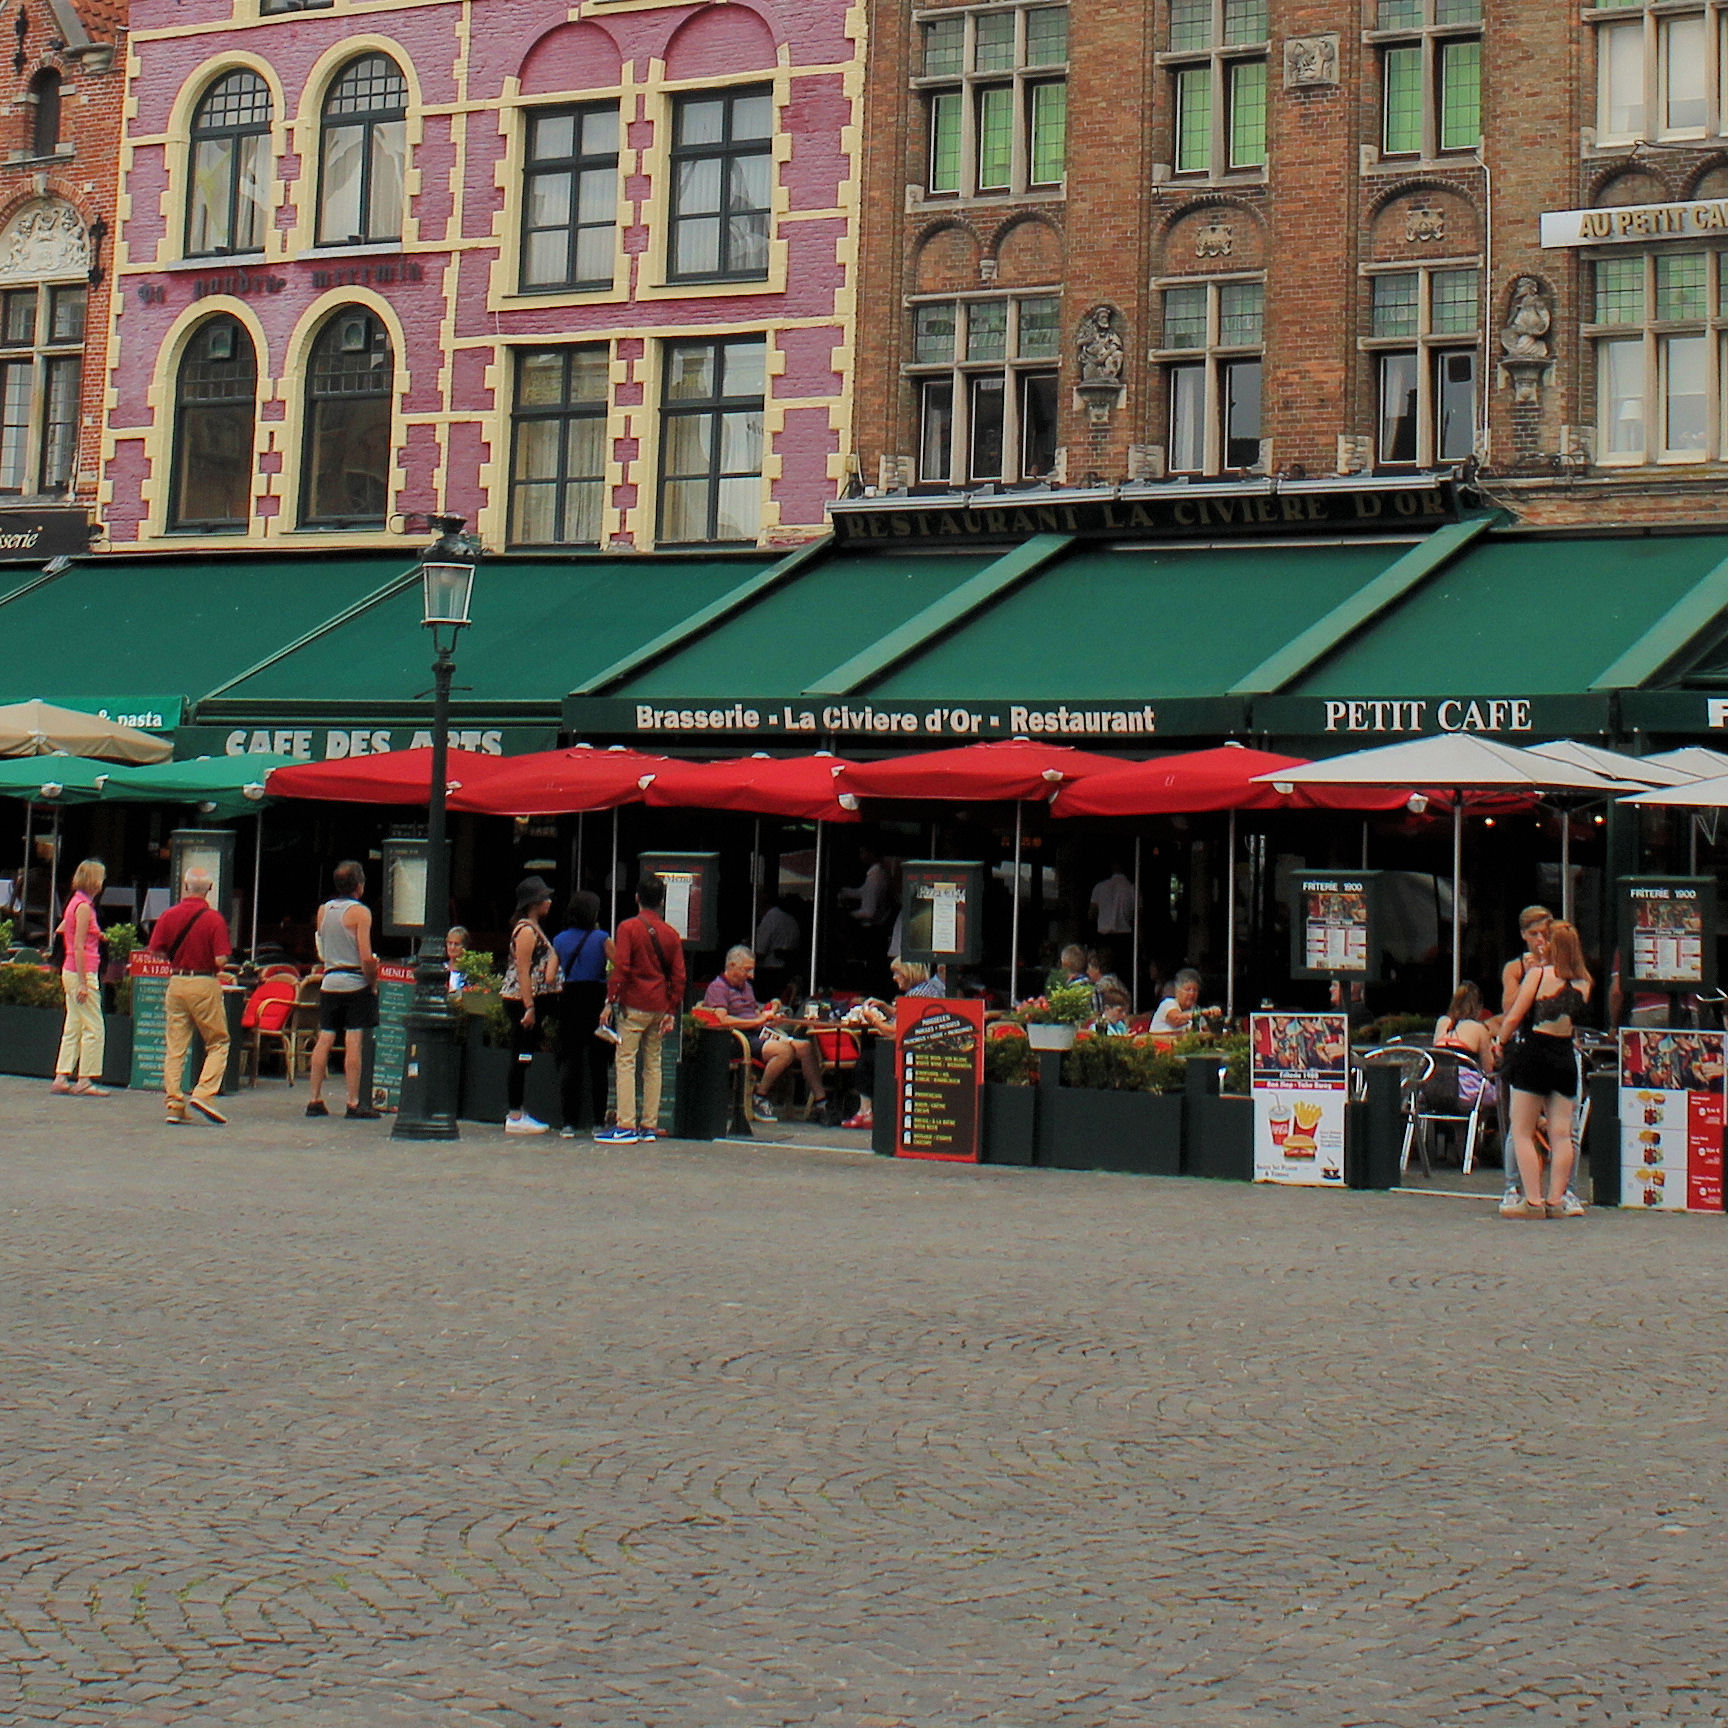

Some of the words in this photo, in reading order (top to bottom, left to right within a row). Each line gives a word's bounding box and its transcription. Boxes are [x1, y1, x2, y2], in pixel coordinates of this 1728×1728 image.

[1579, 213, 1611, 238] AU
[1616, 207, 1686, 236] PETIT
[848, 505, 1078, 538] RESTAURANT
[1103, 503, 1154, 528] LA
[636, 704, 760, 730] Brasserie
[784, 706, 816, 730] La
[824, 705, 918, 732] Civiere
[925, 706, 983, 733] d'Or
[1010, 704, 1156, 735] Restaurant
[1324, 700, 1427, 732] PETIT
[1437, 699, 1533, 732] CAFE
[225, 730, 313, 760] CAFE
[325, 730, 392, 760] DES
[380, 966, 406, 980] MENU
